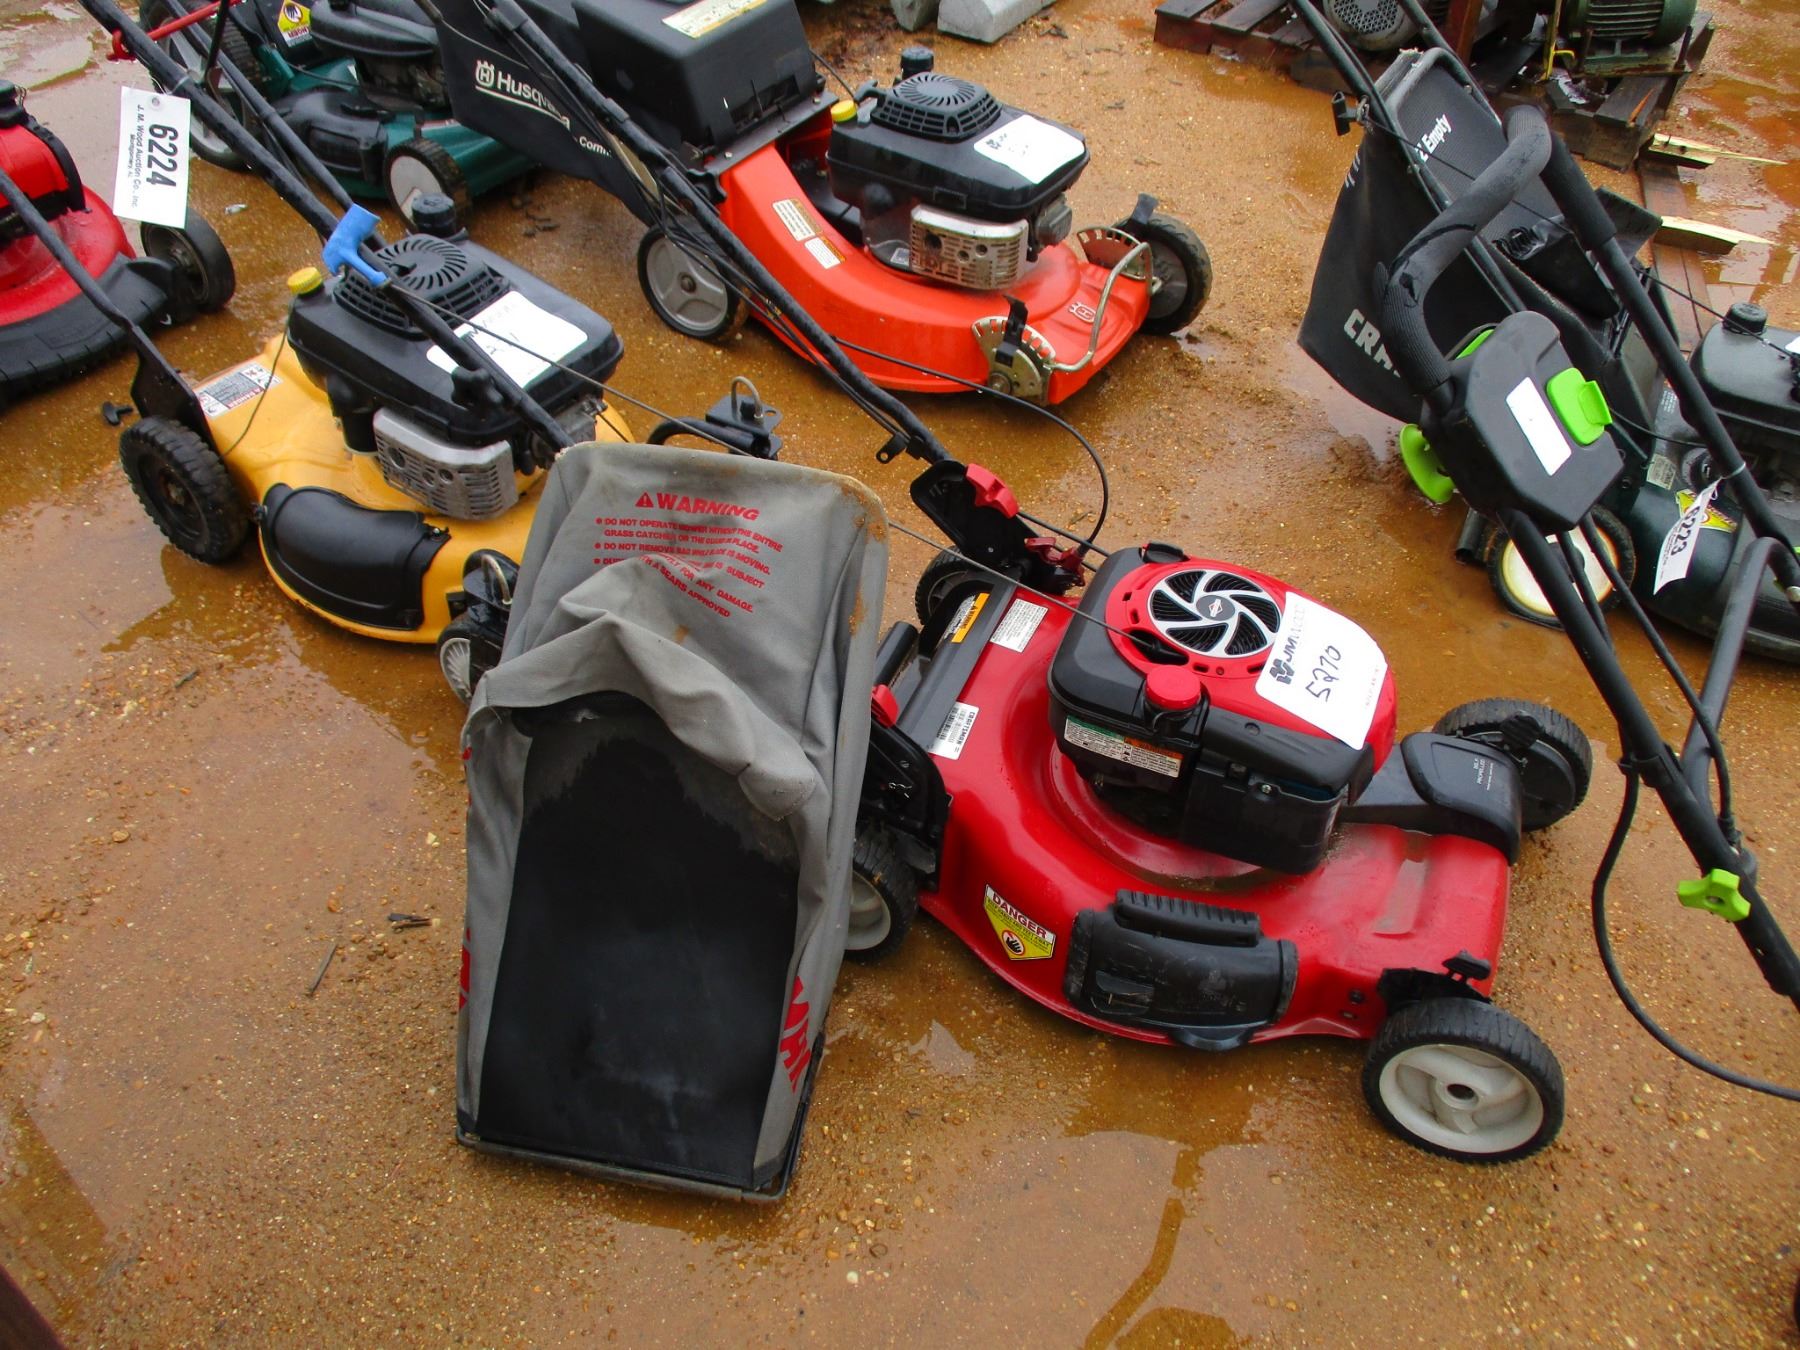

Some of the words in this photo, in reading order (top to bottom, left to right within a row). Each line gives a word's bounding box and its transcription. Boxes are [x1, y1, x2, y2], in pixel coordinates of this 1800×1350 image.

[136, 125, 145, 147] Wood
[1425, 113, 1453, 154] Empty
[134, 149, 143, 177] Auction
[146, 123, 179, 187] 6224
[1343, 308, 1400, 378] CRA
[656, 492, 760, 521] WARNING
[604, 529, 634, 538] GRASS
[636, 531, 677, 541] CATCHER
[605, 518, 617, 526] DO
[619, 518, 638, 527] NOT
[640, 519, 677, 530] OPERATE
[753, 533, 784, 552] ENTIRE
[604, 542, 617, 550] DO
[618, 543, 638, 551] NOT
[639, 544, 674, 553] REMOVE
[736, 552, 771, 575] MOVING.
[660, 565, 688, 592] SEARS
[688, 589, 731, 618] APPROVED
[680, 566, 695, 580] FOR
[696, 580, 715, 592] ANY
[727, 566, 765, 588] SUBJECT
[992, 892, 1047, 939] DANGER
